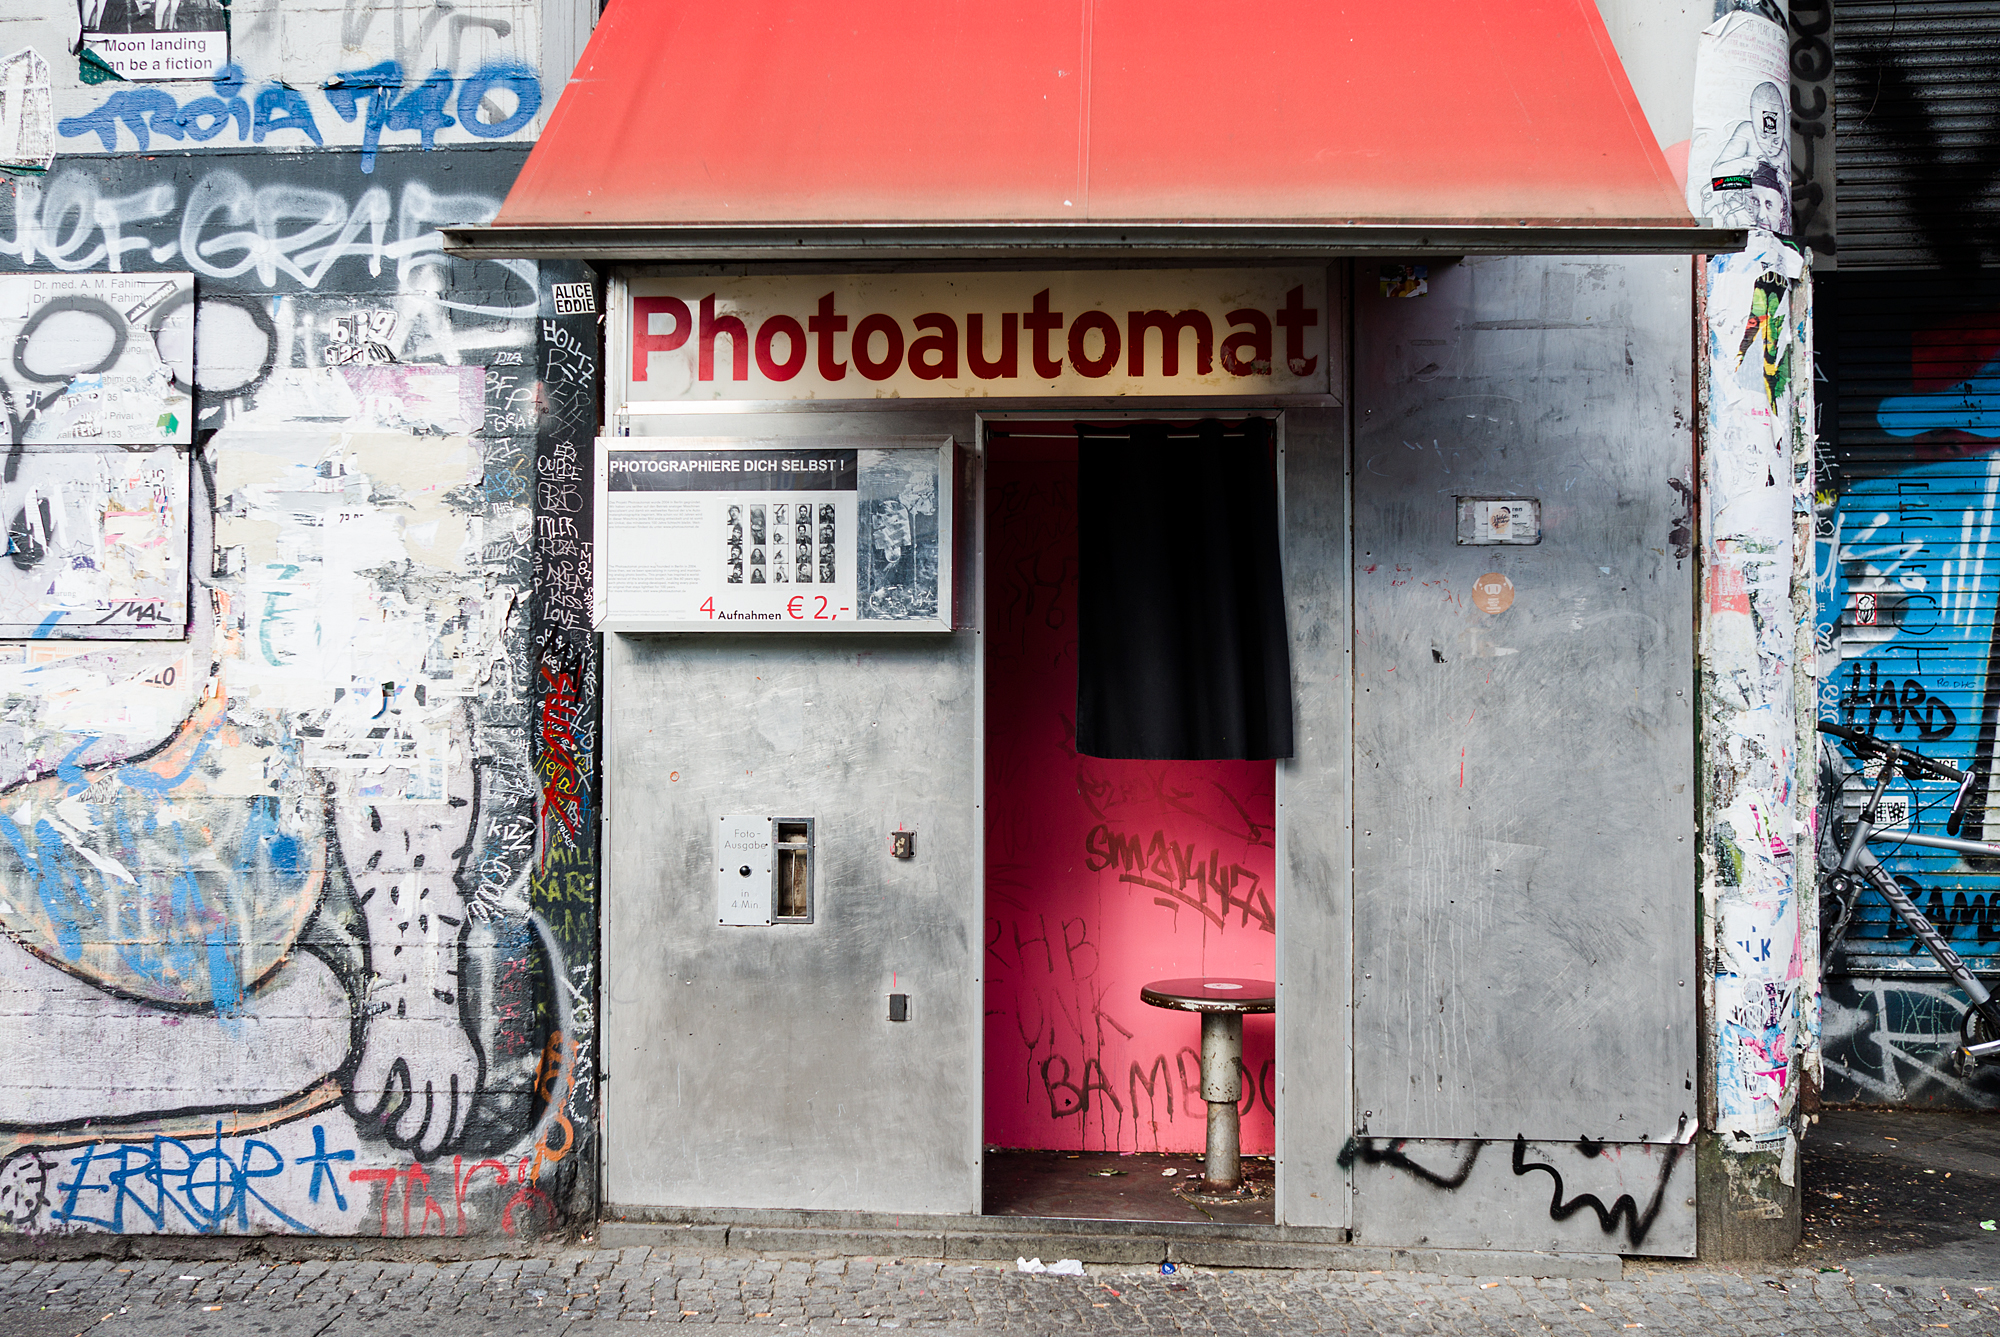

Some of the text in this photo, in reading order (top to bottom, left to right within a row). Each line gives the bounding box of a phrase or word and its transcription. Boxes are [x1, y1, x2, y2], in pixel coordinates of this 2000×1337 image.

[105, 38, 206, 52] Moon landing
[108, 57, 212, 71] an be a fiction
[34, 279, 146, 290] Dr. med. A. M. Fahimi
[33, 294, 48, 303] Dr.
[111, 293, 147, 303] Fahimi
[556, 285, 592, 299] ALICE
[557, 299, 595, 313] EDDIE
[632, 284, 1318, 382] Photoautomat
[102, 374, 137, 383] ahimi.de
[107, 431, 122, 439] 133
[610, 459, 845, 473] PHOTOGRAPHIERE DICH SELBST !
[537, 516, 578, 539] TYLER
[700, 596, 715, 620] 4
[718, 610, 781, 620] Aufnahmen
[787, 596, 804, 620] €
[814, 596, 849, 621] 2,-
[543, 602, 584, 631] LOVE
[1840, 661, 1957, 740] HARD
[735, 829, 760, 839] Foto-
[724, 841, 766, 851] Ausgabe
[741, 889, 749, 897] in
[740, 900, 761, 909] Min.
